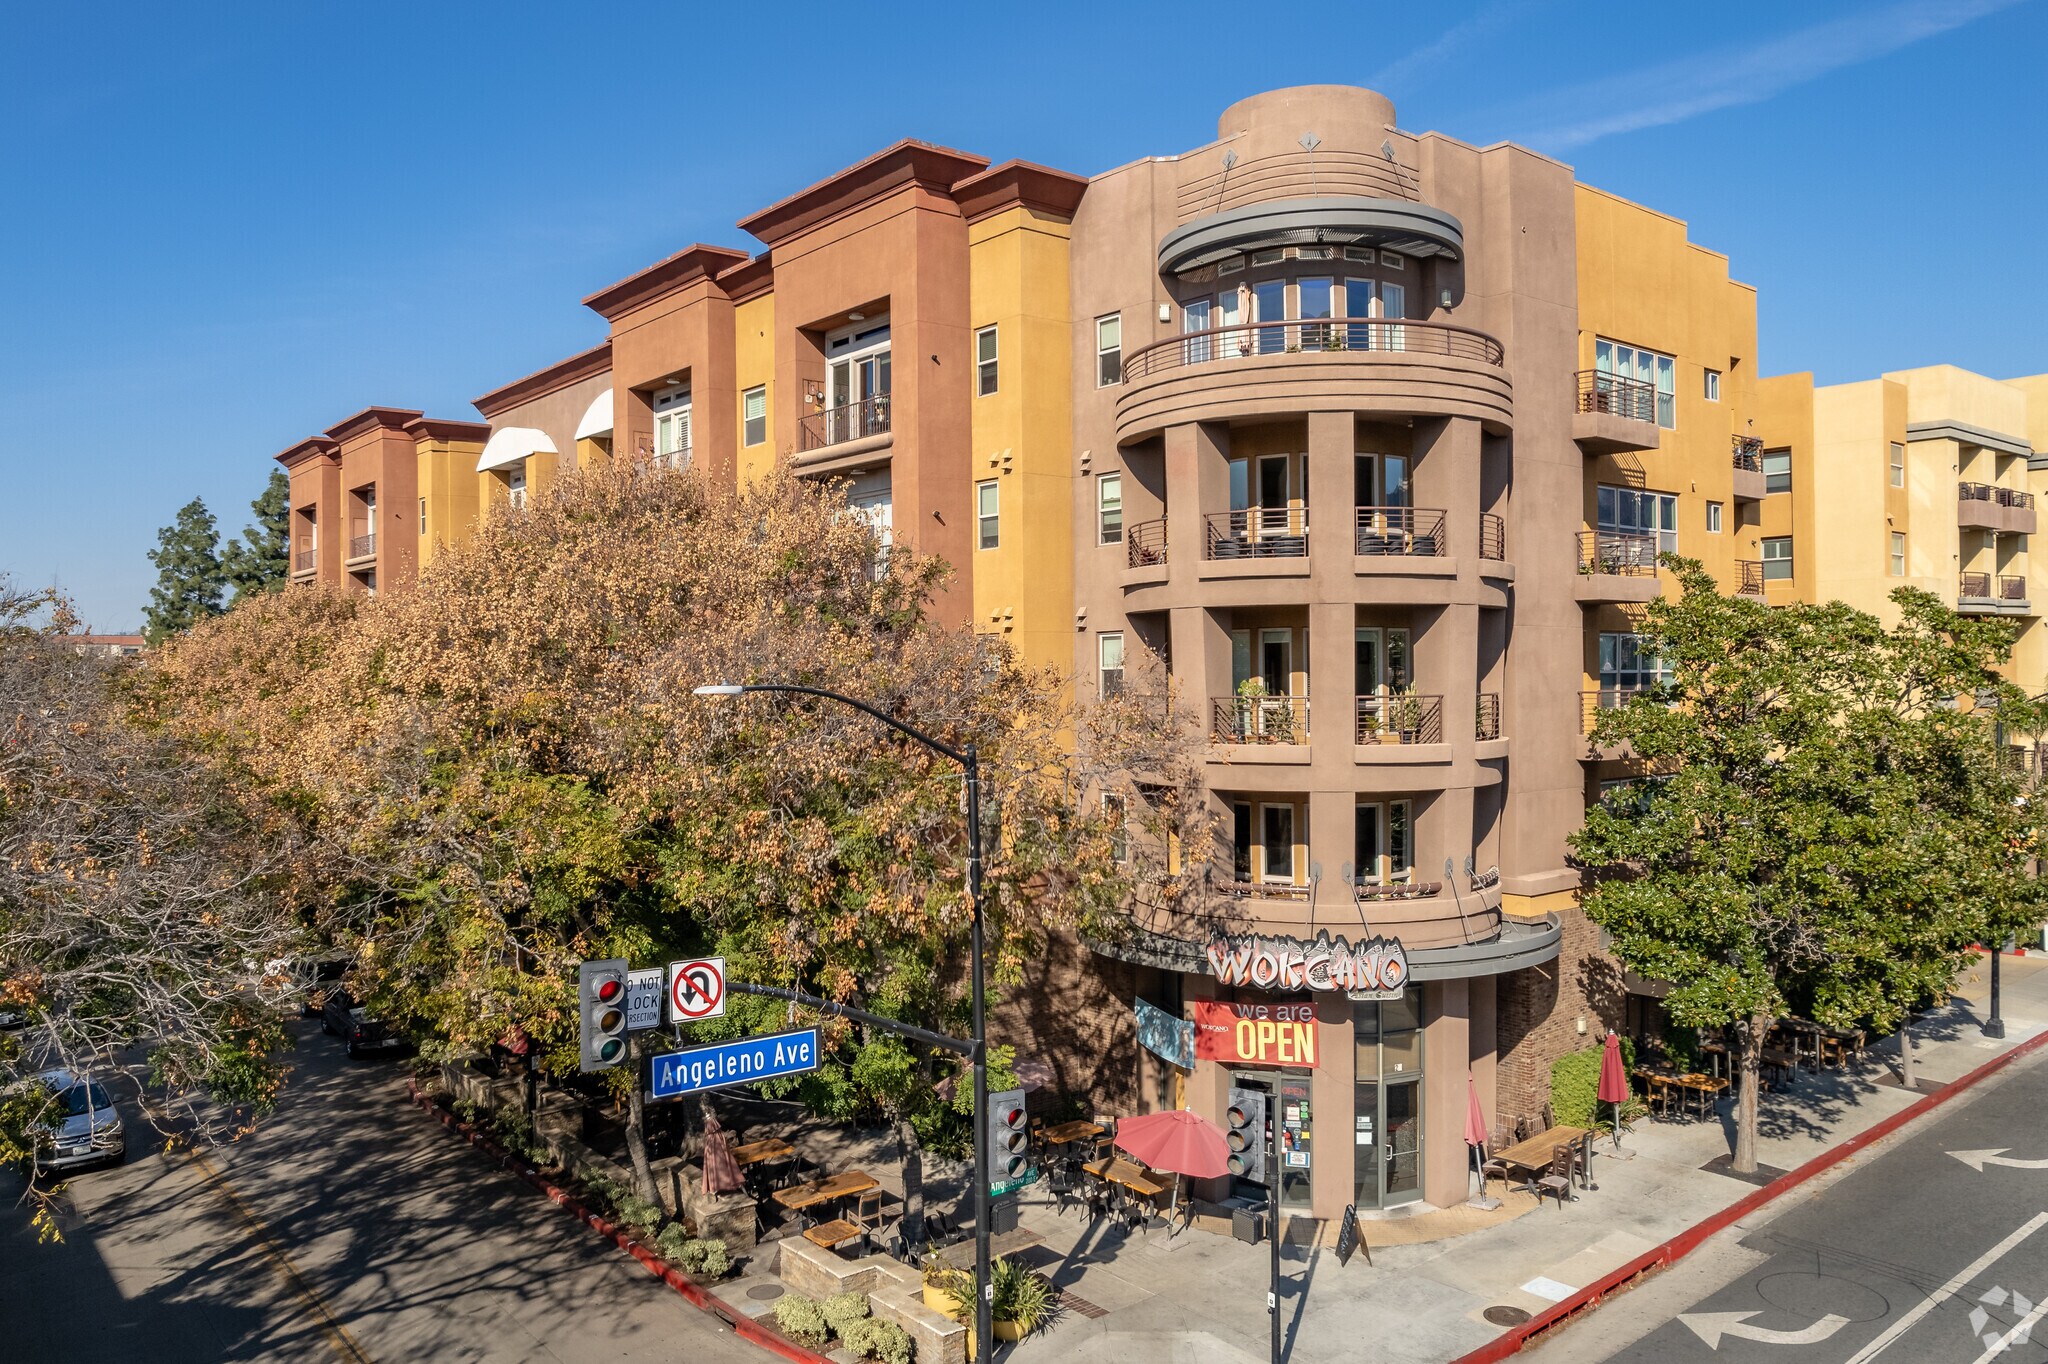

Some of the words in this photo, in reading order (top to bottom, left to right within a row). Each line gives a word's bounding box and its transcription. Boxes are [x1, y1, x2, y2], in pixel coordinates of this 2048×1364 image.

[1207, 949, 1408, 990] WOKCANO
[640, 976, 660, 990] NOT
[627, 995, 659, 1010] LOCK
[1236, 1003, 1269, 1019] we
[1276, 1004, 1313, 1022] are
[1236, 1019, 1315, 1064] OPEN
[660, 1051, 765, 1088] Angeleno
[773, 1041, 810, 1067] Ave
[1281, 1086, 1307, 1097] OPEN
